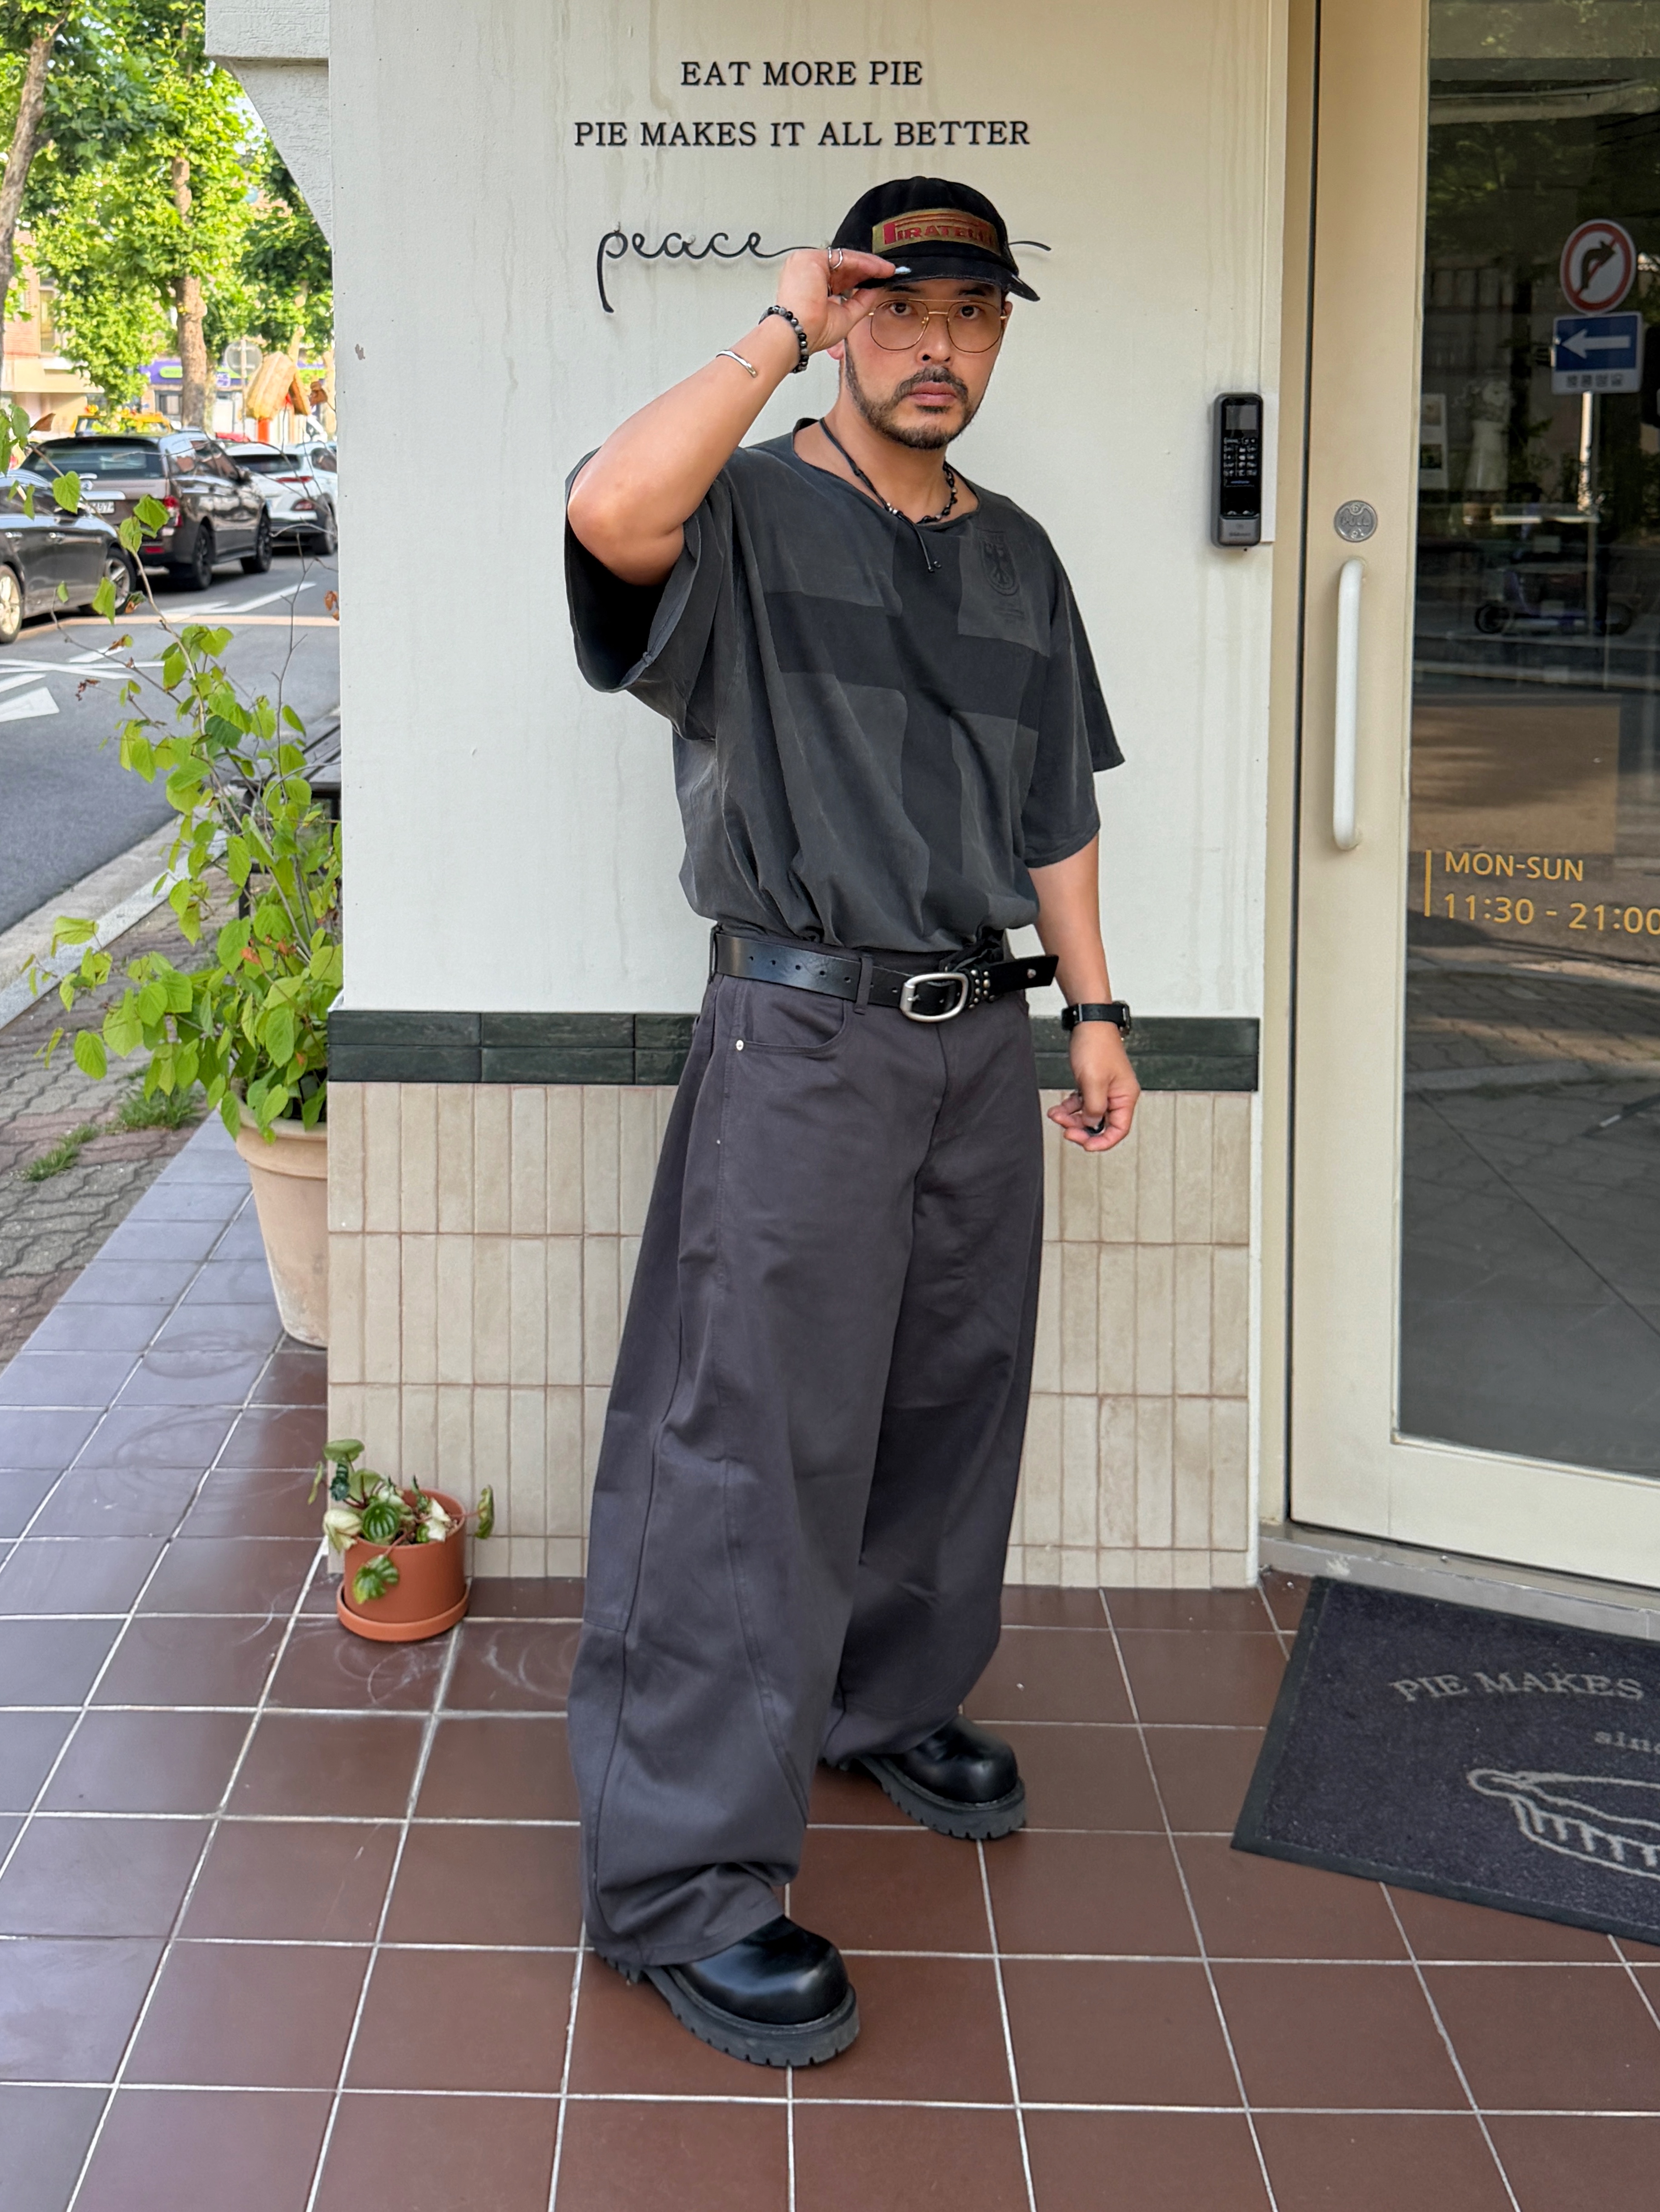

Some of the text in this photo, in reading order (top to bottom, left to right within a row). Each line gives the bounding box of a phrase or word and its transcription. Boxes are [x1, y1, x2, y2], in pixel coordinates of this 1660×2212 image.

[681, 61, 922, 86] EAT MORE PIE
[575, 121, 1030, 146] PIE MAKES IT ALL BETTER
[597, 231, 800, 313] peace
[1445, 851, 1582, 881] MON-SUN
[1445, 894, 1534, 925] 11:30
[1569, 903, 1660, 935] 21:00
[1391, 1672, 1643, 1701] PIE MAKES
